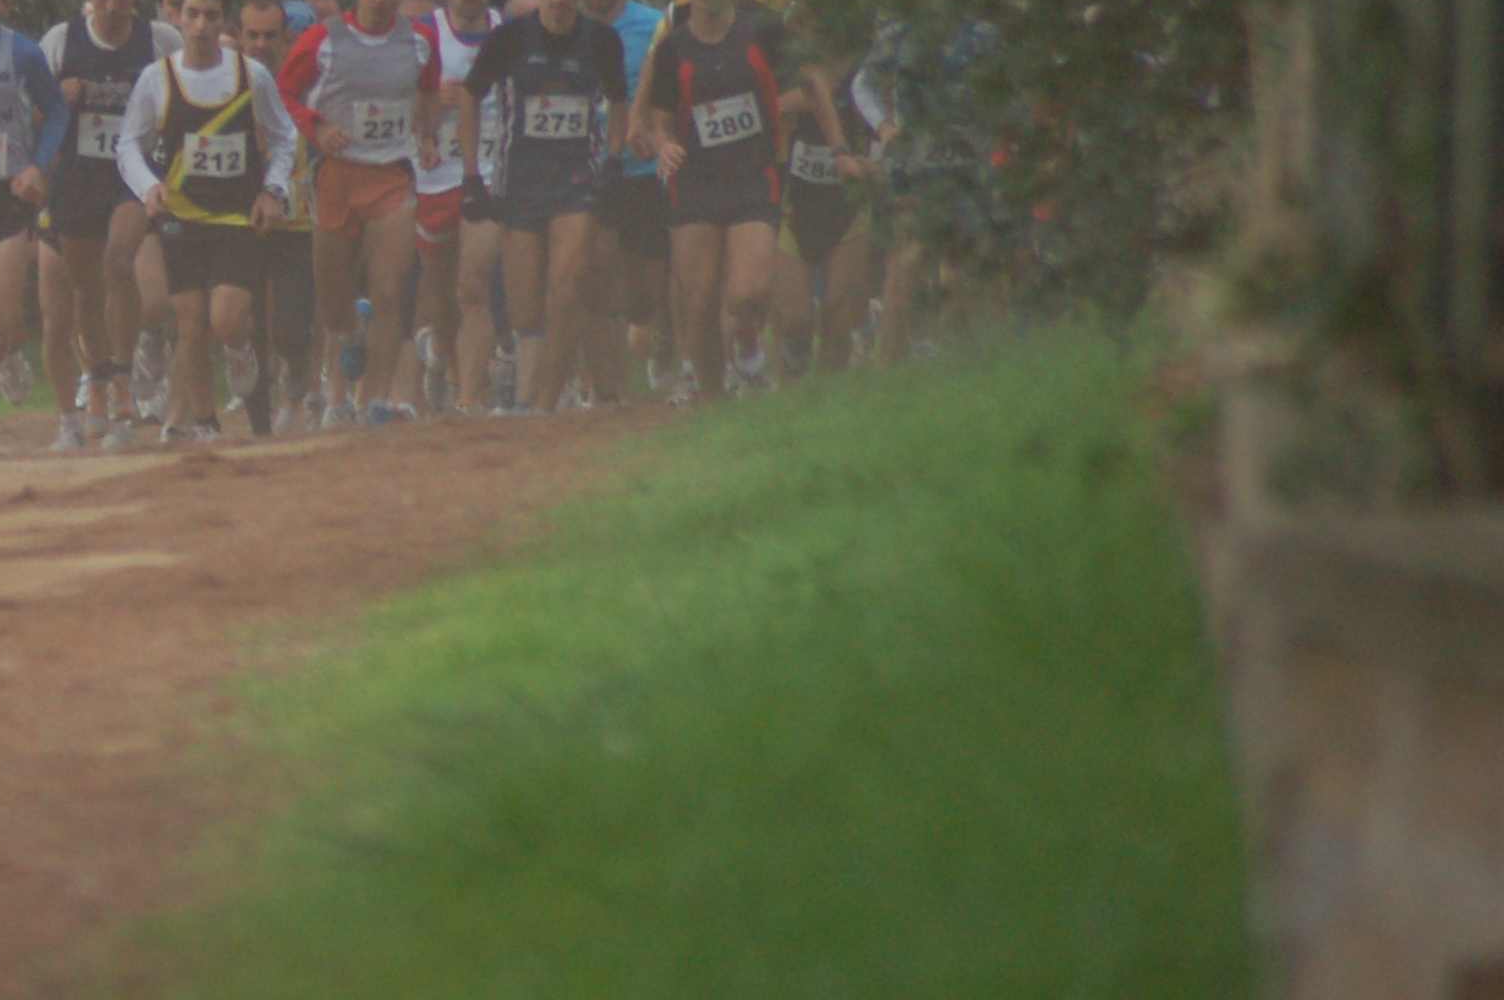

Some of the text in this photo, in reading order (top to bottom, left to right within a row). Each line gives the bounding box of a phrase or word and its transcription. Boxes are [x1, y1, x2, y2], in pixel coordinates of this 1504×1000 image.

[363, 115, 405, 140] 221
[533, 112, 583, 133] 275
[705, 111, 755, 139] 280
[448, 137, 496, 158] 27
[193, 150, 241, 171] 212
